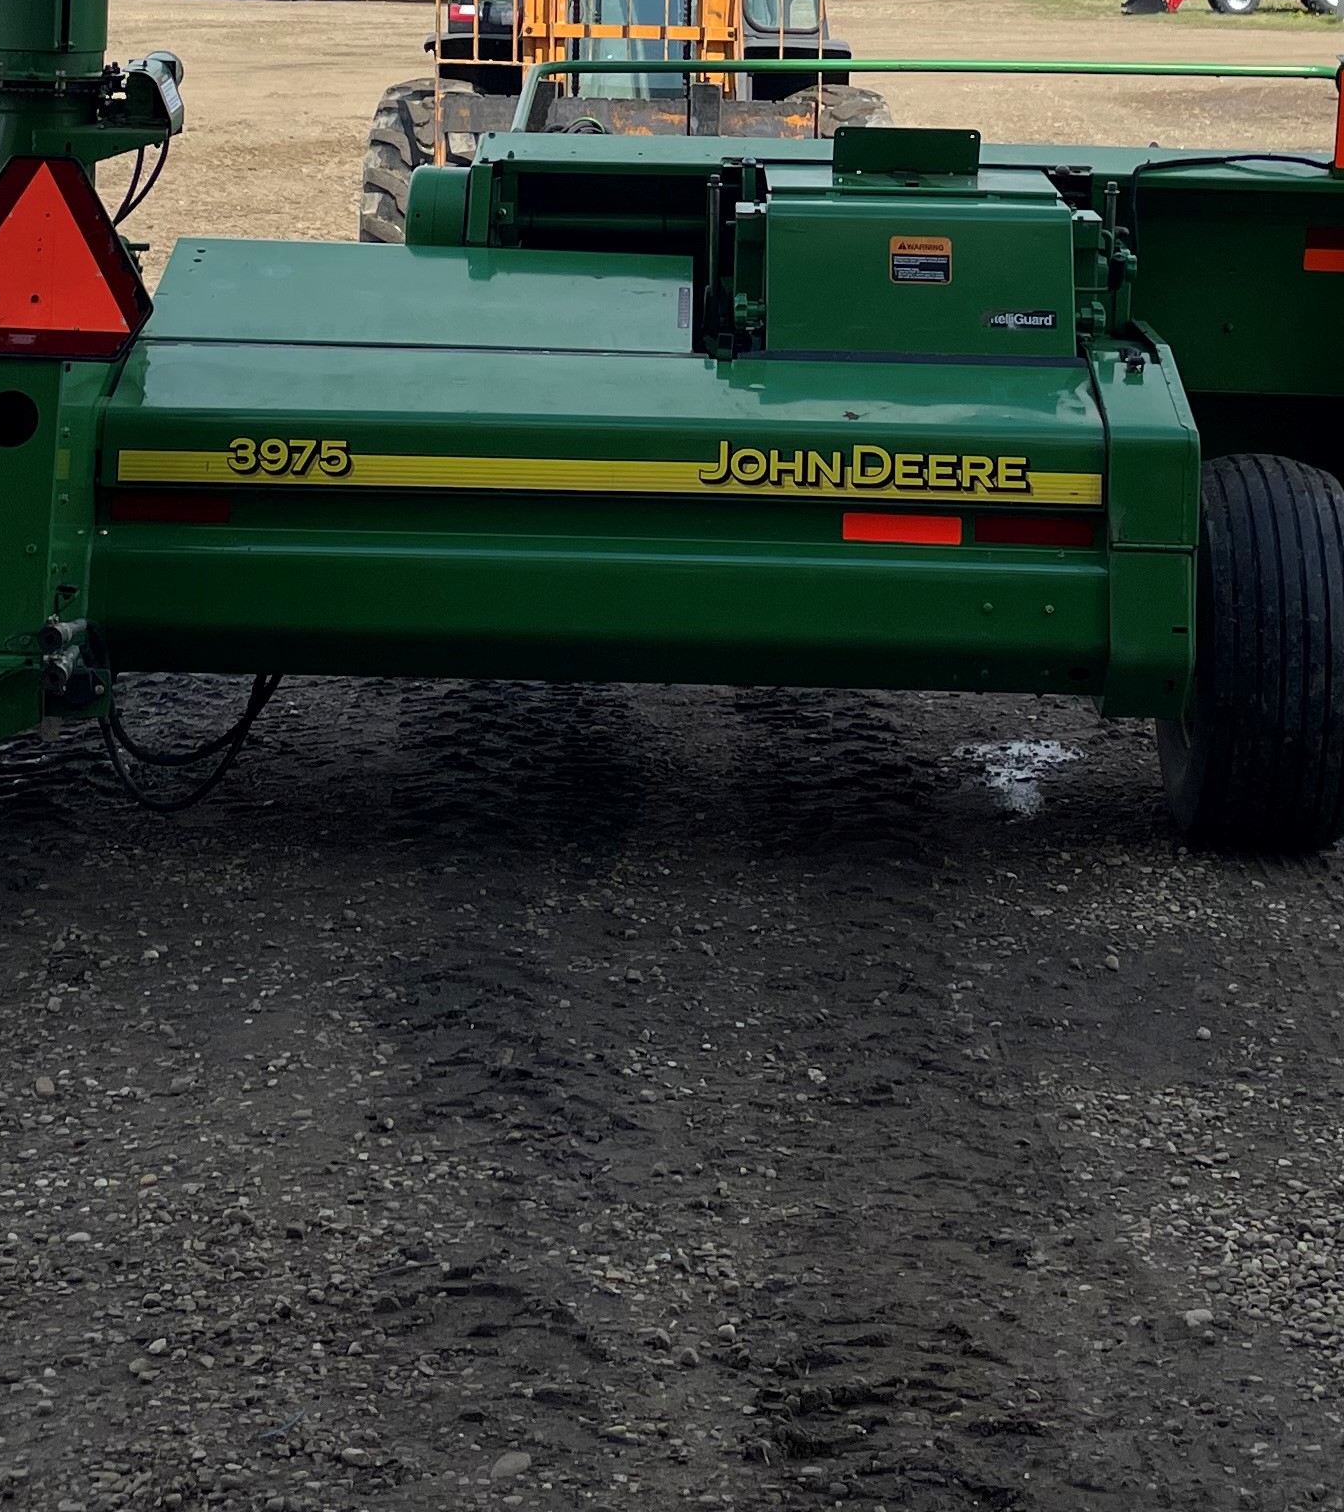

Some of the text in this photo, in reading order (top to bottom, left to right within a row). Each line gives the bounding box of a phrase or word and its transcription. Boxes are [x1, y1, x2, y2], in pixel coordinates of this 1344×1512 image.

[906, 242, 945, 252] WARNING
[227, 437, 352, 478] 3975
[699, 440, 1030, 492] JOHN DEERE
